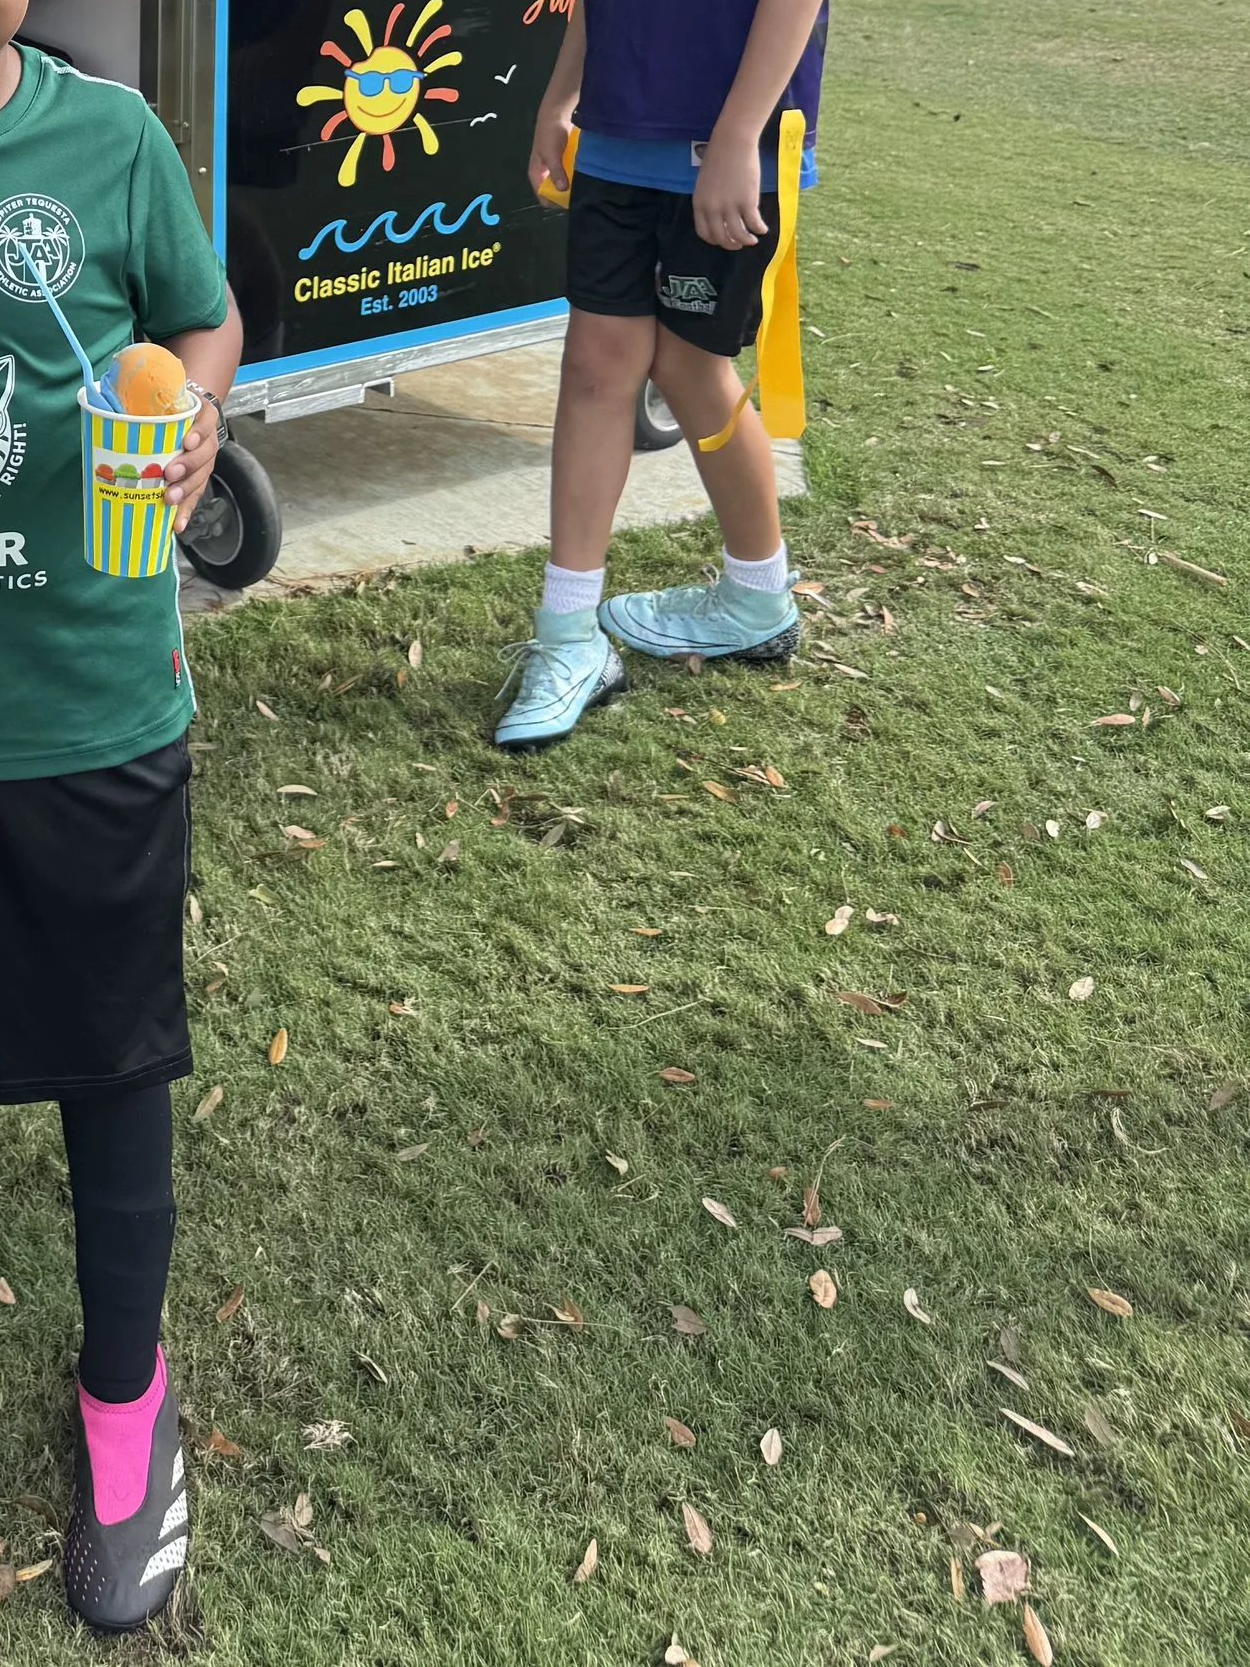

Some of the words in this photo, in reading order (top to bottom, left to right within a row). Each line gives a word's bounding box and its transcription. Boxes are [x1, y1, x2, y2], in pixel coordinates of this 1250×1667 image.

[25, 197, 71, 226] TEQUESTA
[294, 267, 381, 302] Classic
[387, 254, 455, 285] Italian
[360, 295, 394, 316] Est.
[398, 284, 438, 308] 2003
[0, 422, 27, 486] RIGHT!
